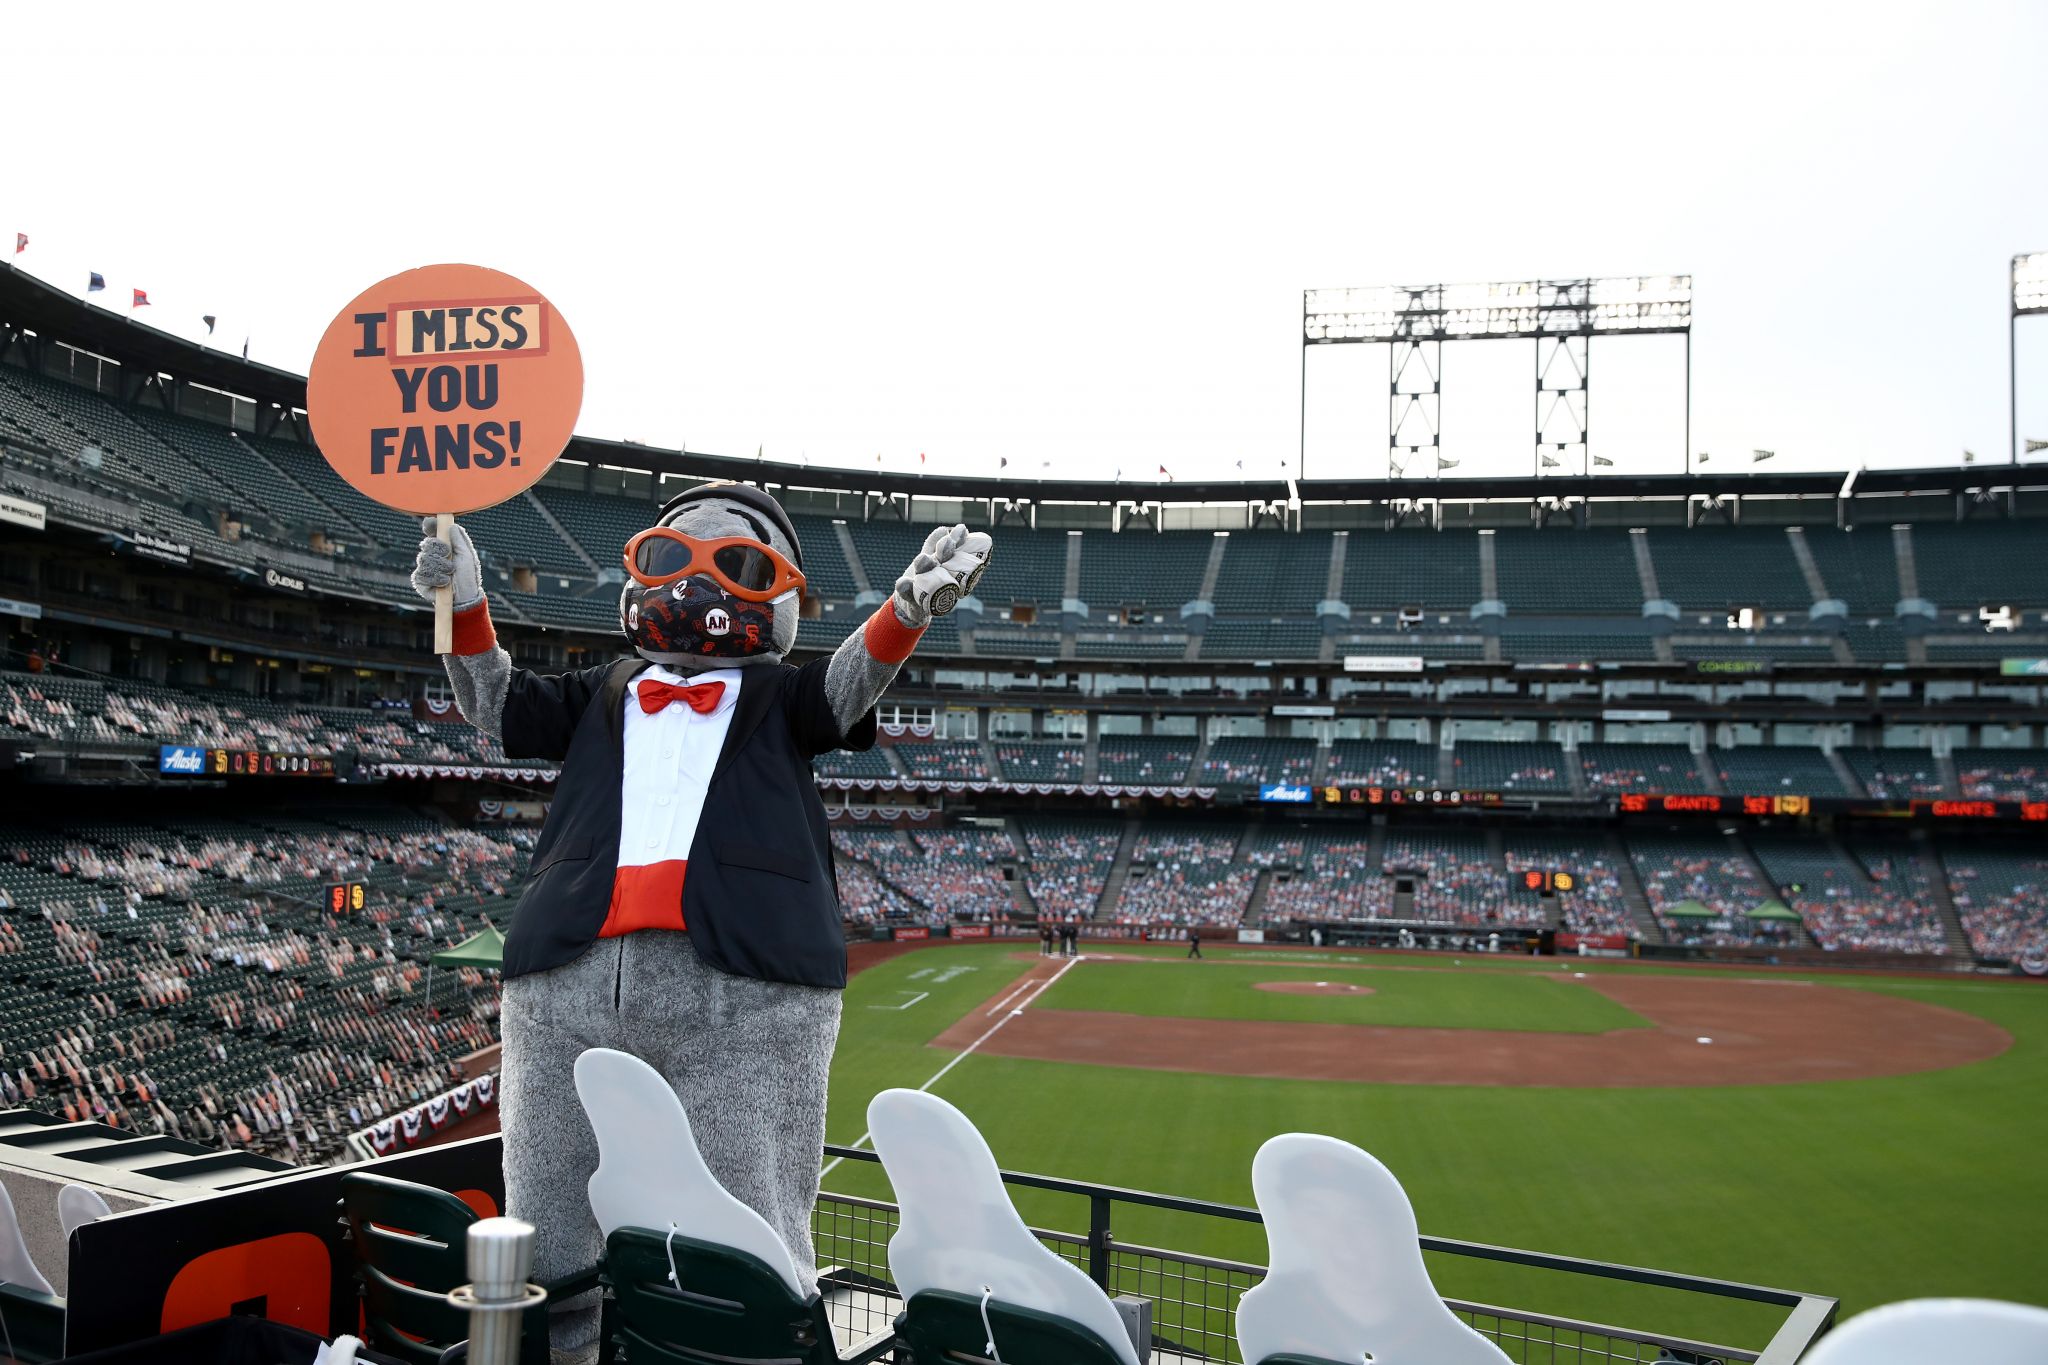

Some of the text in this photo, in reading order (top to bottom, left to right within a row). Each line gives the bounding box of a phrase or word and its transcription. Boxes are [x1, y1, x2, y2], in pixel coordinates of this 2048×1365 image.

[353, 305, 528, 358] I MISS
[391, 364, 499, 414] YOU
[370, 420, 521, 475] FANS!
[165, 748, 202, 772] Alaska
[1264, 785, 1308, 802] Alaska
[1663, 795, 1721, 811] GIANTS
[1932, 799, 1996, 817] GIANTS
